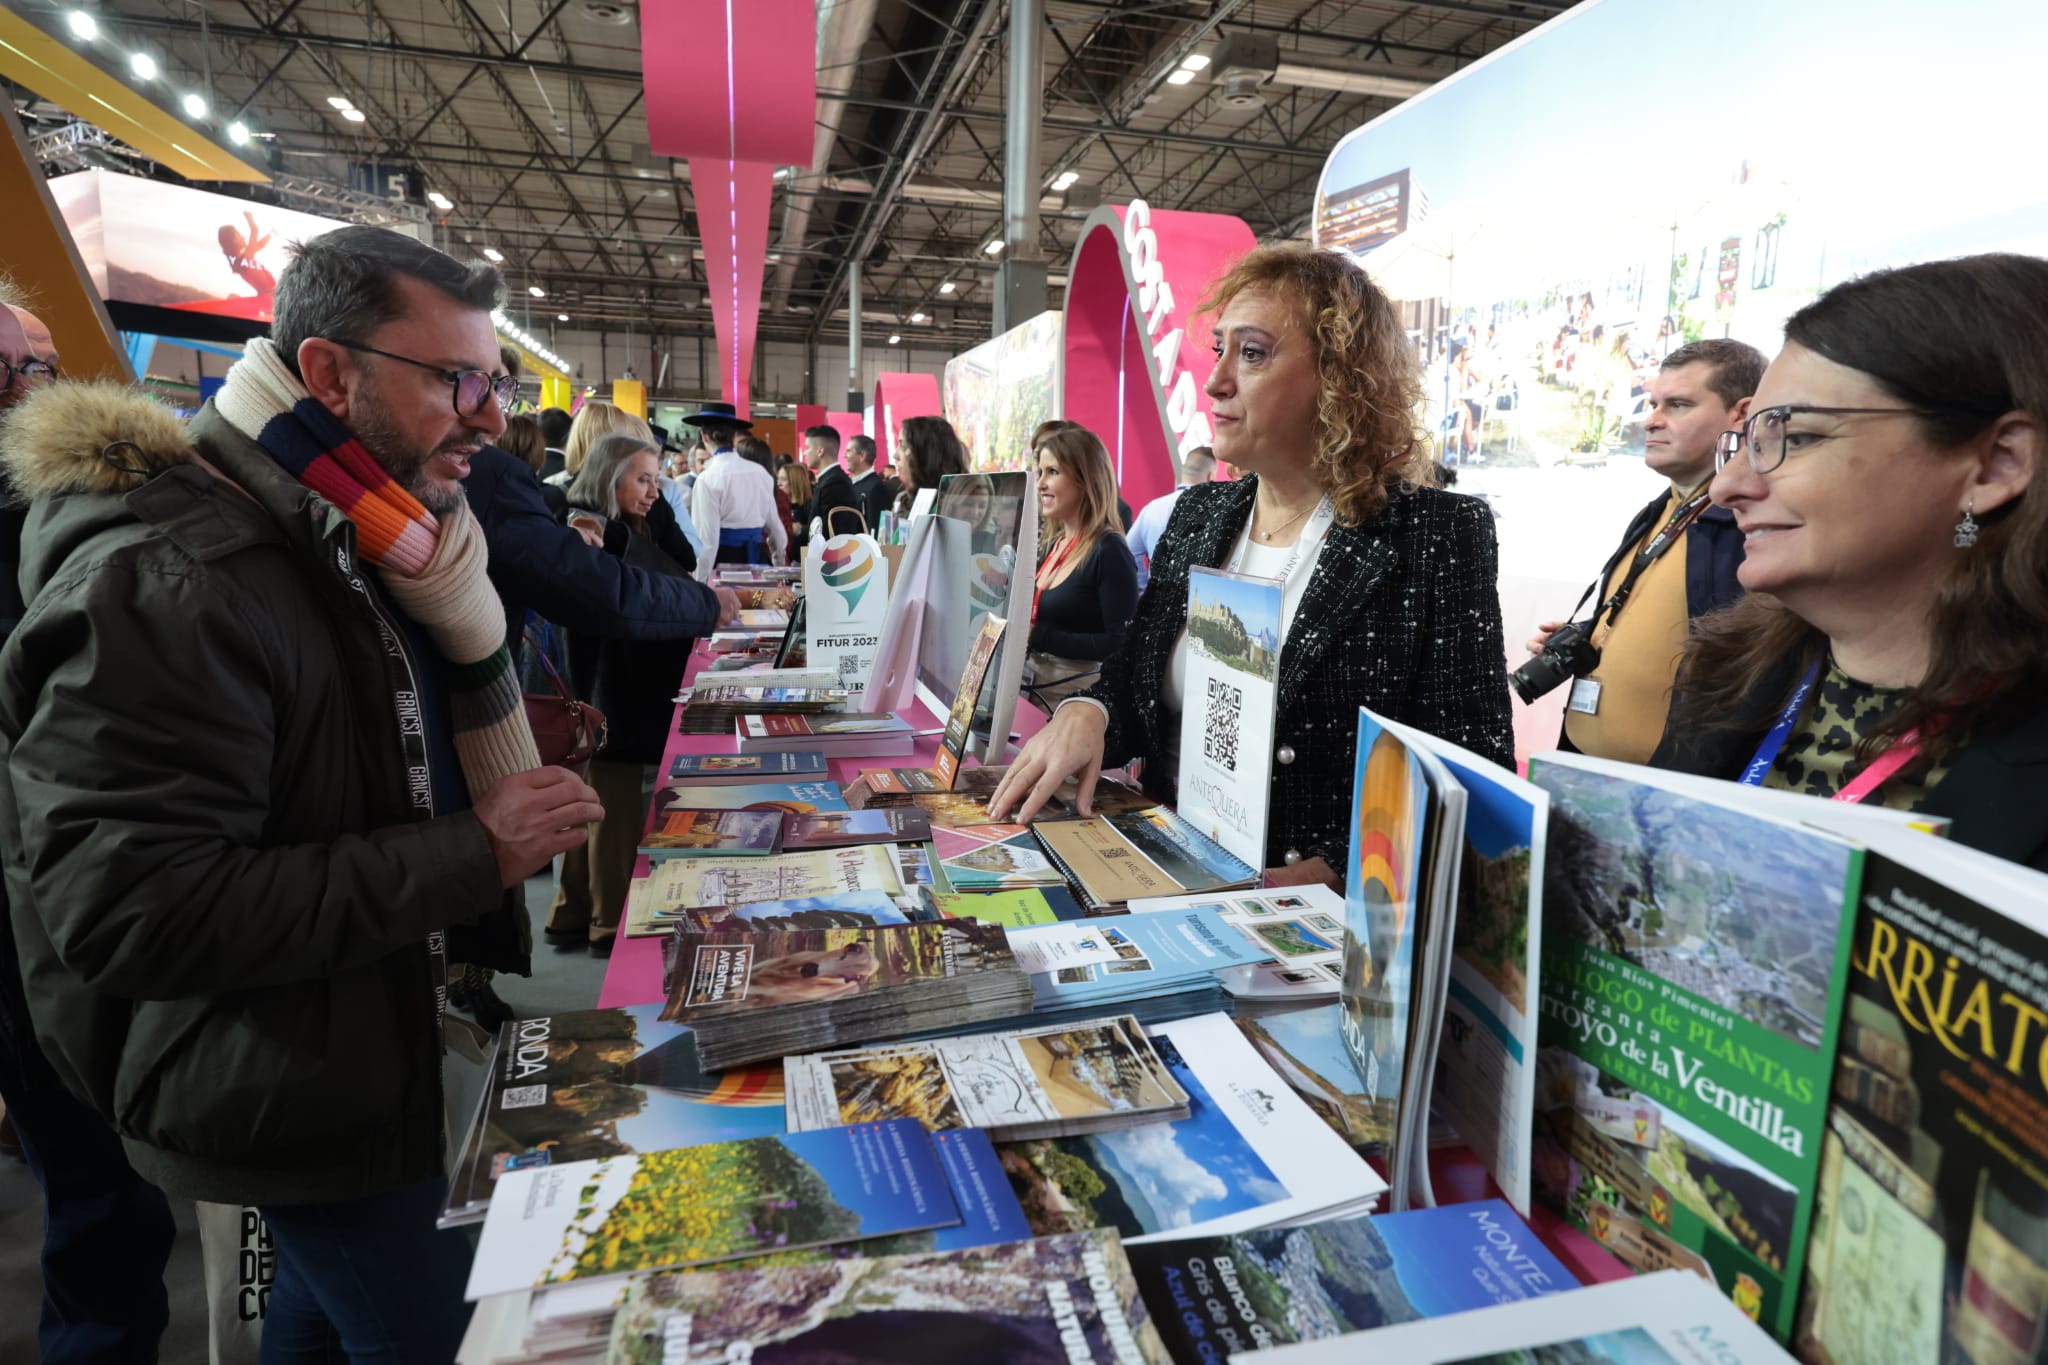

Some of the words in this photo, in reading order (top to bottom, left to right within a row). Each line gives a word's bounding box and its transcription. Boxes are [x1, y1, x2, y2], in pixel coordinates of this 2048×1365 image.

[816, 638, 850, 648] FITUR
[396, 690, 421, 737] GRNCST
[408, 765, 431, 809] GRNCST
[711, 950, 730, 1001] AVENTURA
[730, 974, 743, 987] LA
[733, 949, 747, 974] VIVE
[1583, 949, 1616, 973] Juan
[1660, 985, 1735, 1031] Pimentel
[514, 1016, 552, 1080] RONDA
[1539, 994, 1618, 1048] rroyo
[1620, 1037, 1648, 1065] de
[1650, 1050, 1670, 1079] la
[1669, 1044, 1805, 1159] Ventilla
[1650, 1002, 1680, 1033] de
[1687, 1019, 1816, 1105] PLANTAS
[1600, 1051, 1688, 1112] ARRIATE
[240, 1209, 275, 1249] PA
[1468, 1210, 1554, 1293] MONTE
[1163, 1267, 1193, 1311] Azul
[1183, 1310, 1205, 1338] de
[1186, 1256, 1214, 1297] Gris
[1206, 1296, 1230, 1325] de
[1213, 1256, 1257, 1324] Blanco
